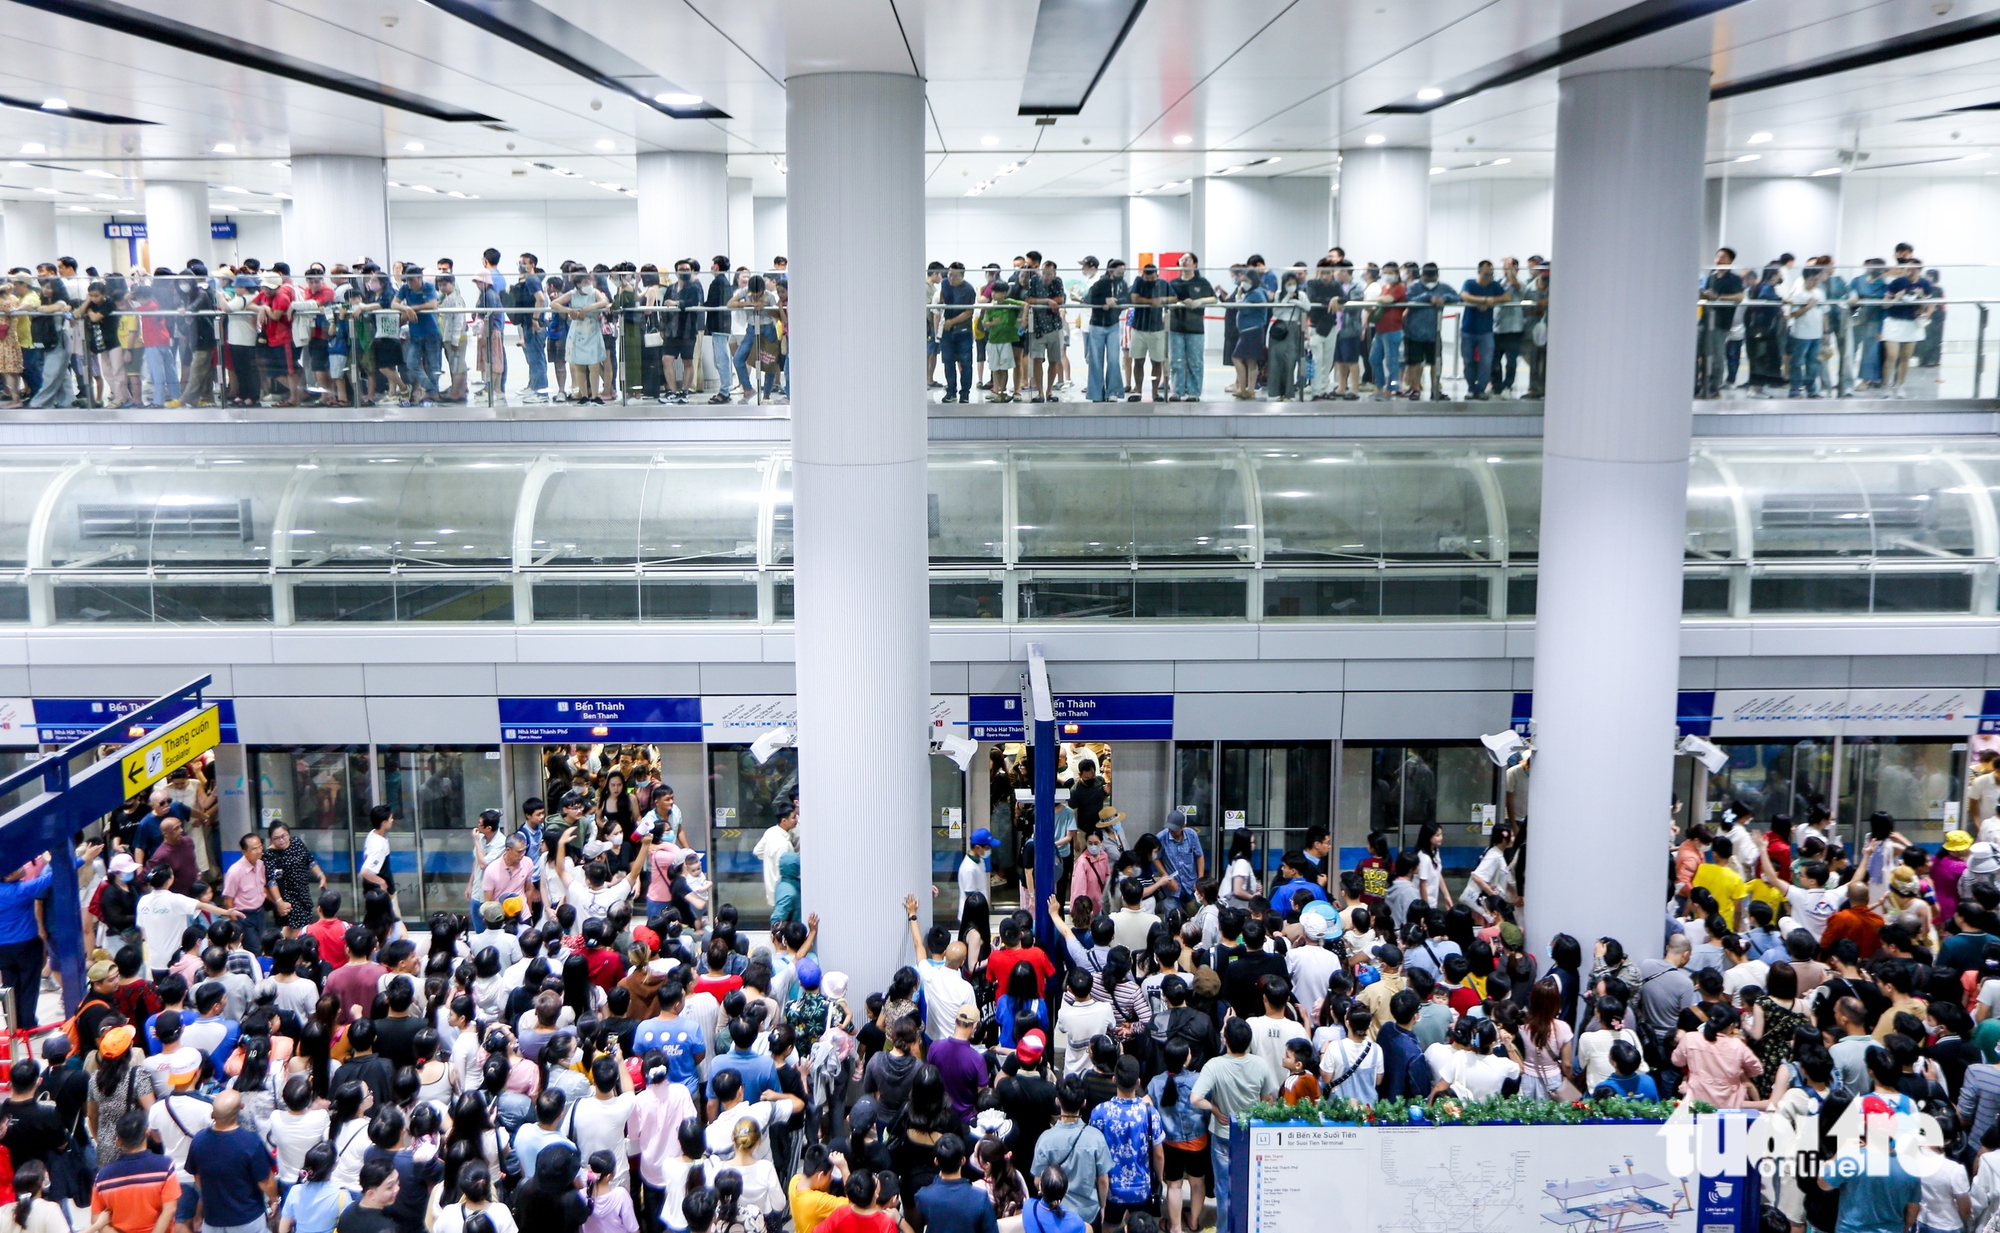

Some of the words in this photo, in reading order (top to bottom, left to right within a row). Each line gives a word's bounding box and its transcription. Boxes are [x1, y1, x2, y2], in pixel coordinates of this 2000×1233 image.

[109, 702, 127, 712] Bến
[575, 701, 593, 711] Bến
[595, 702, 625, 711] Thành
[1053, 698, 1064, 708] ến
[1066, 699, 1096, 708] Thành
[165, 731, 189, 754] Thang
[191, 717, 210, 738] cuốn
[166, 746, 192, 768] Escalator
[1276, 1132, 1282, 1146] 1
[1288, 1131, 1295, 1139] đi
[1296, 1131, 1311, 1139] Bến
[1323, 1131, 1340, 1139] Suối
